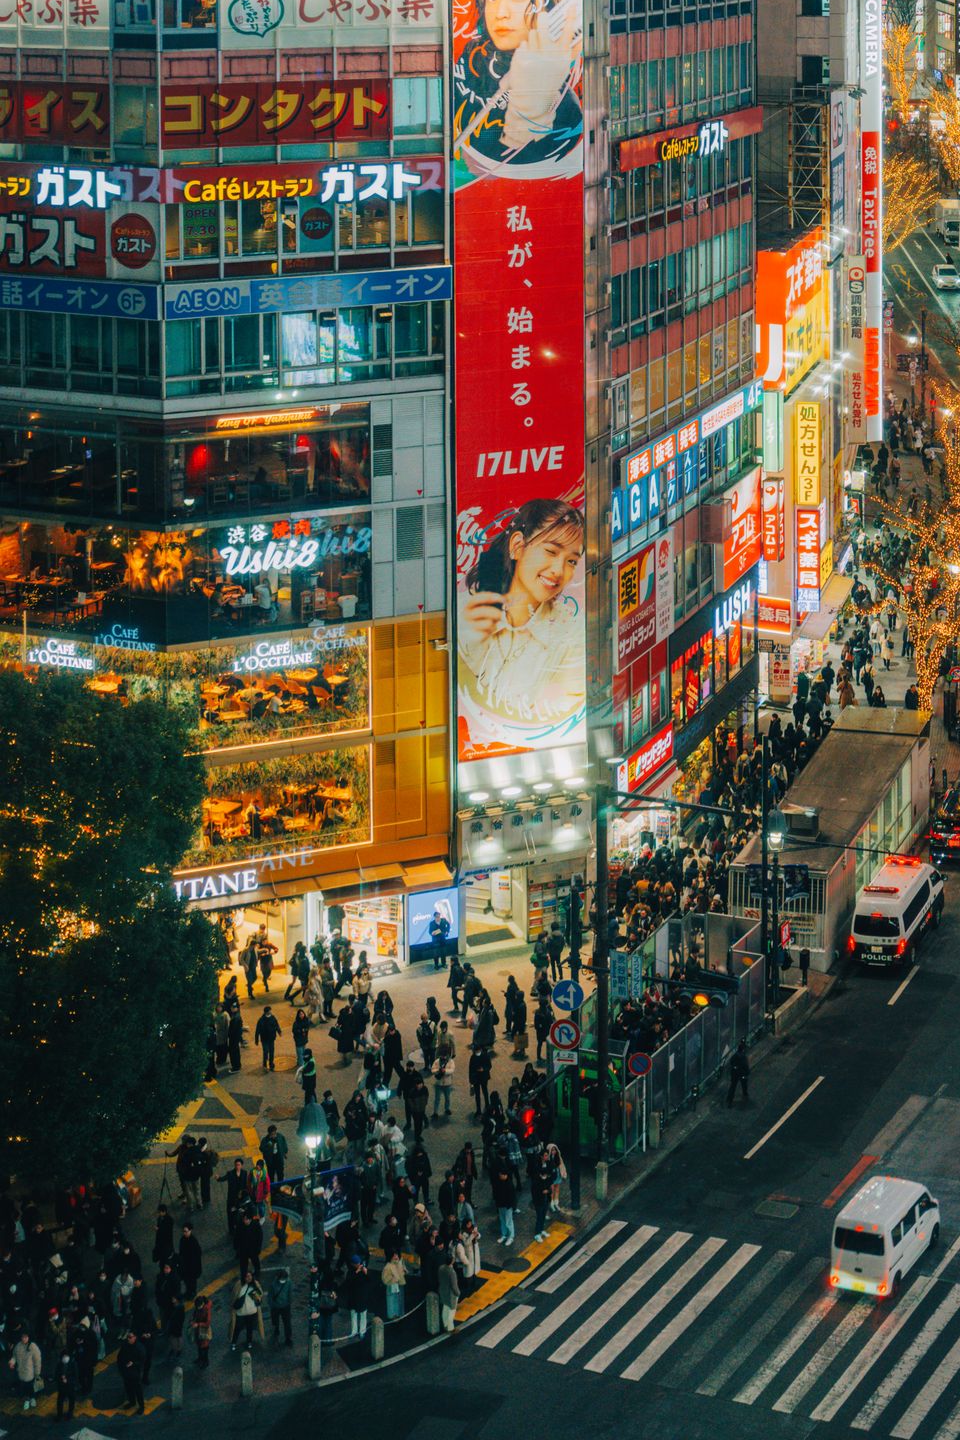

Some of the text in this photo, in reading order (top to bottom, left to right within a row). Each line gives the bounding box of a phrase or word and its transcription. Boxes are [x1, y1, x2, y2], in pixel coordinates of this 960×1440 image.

[865, 0, 879, 77] CAMERA
[164, 88, 384, 131] コンタクト
[699, 120, 728, 156] ガスト
[37, 167, 121, 208] ガスト
[321, 163, 421, 203] ガスト
[185, 209, 216, 219] OPEN
[864, 187, 877, 258] TaxFree
[117, 237, 151, 253] ガスト
[120, 293, 144, 308] 6F
[177, 289, 239, 308] AEON
[258, 274, 445, 309] 英会話イーオン
[506, 205, 533, 428] 私が、始まる。
[850, 295, 862, 339] 調剤薬局
[747, 381, 762, 408] 4F
[852, 373, 863, 428] 処方せん受付
[800, 407, 817, 475] 処方せん
[804, 478, 814, 502] 3F
[228, 520, 310, 544] 渋谷 焼肉
[765, 515, 776, 545] アコム
[220, 540, 319, 575] Ushi8
[799, 514, 818, 586] スギ薬局
[621, 566, 637, 613] 薬
[715, 579, 751, 638] LUSH
[760, 606, 789, 624] 薬局
[46, 639, 75, 655] CAFÉ
[256, 642, 290, 657] CAFÉ
[619, 616, 656, 658] サンドラッグ
[29, 649, 94, 670] L'OCCITANE
[233, 652, 313, 672] L'OCCITANE
[638, 730, 672, 770] サンドラッグ
[465, 866, 498, 874] SHIBUYA
[861, 953, 893, 962] POLICE
